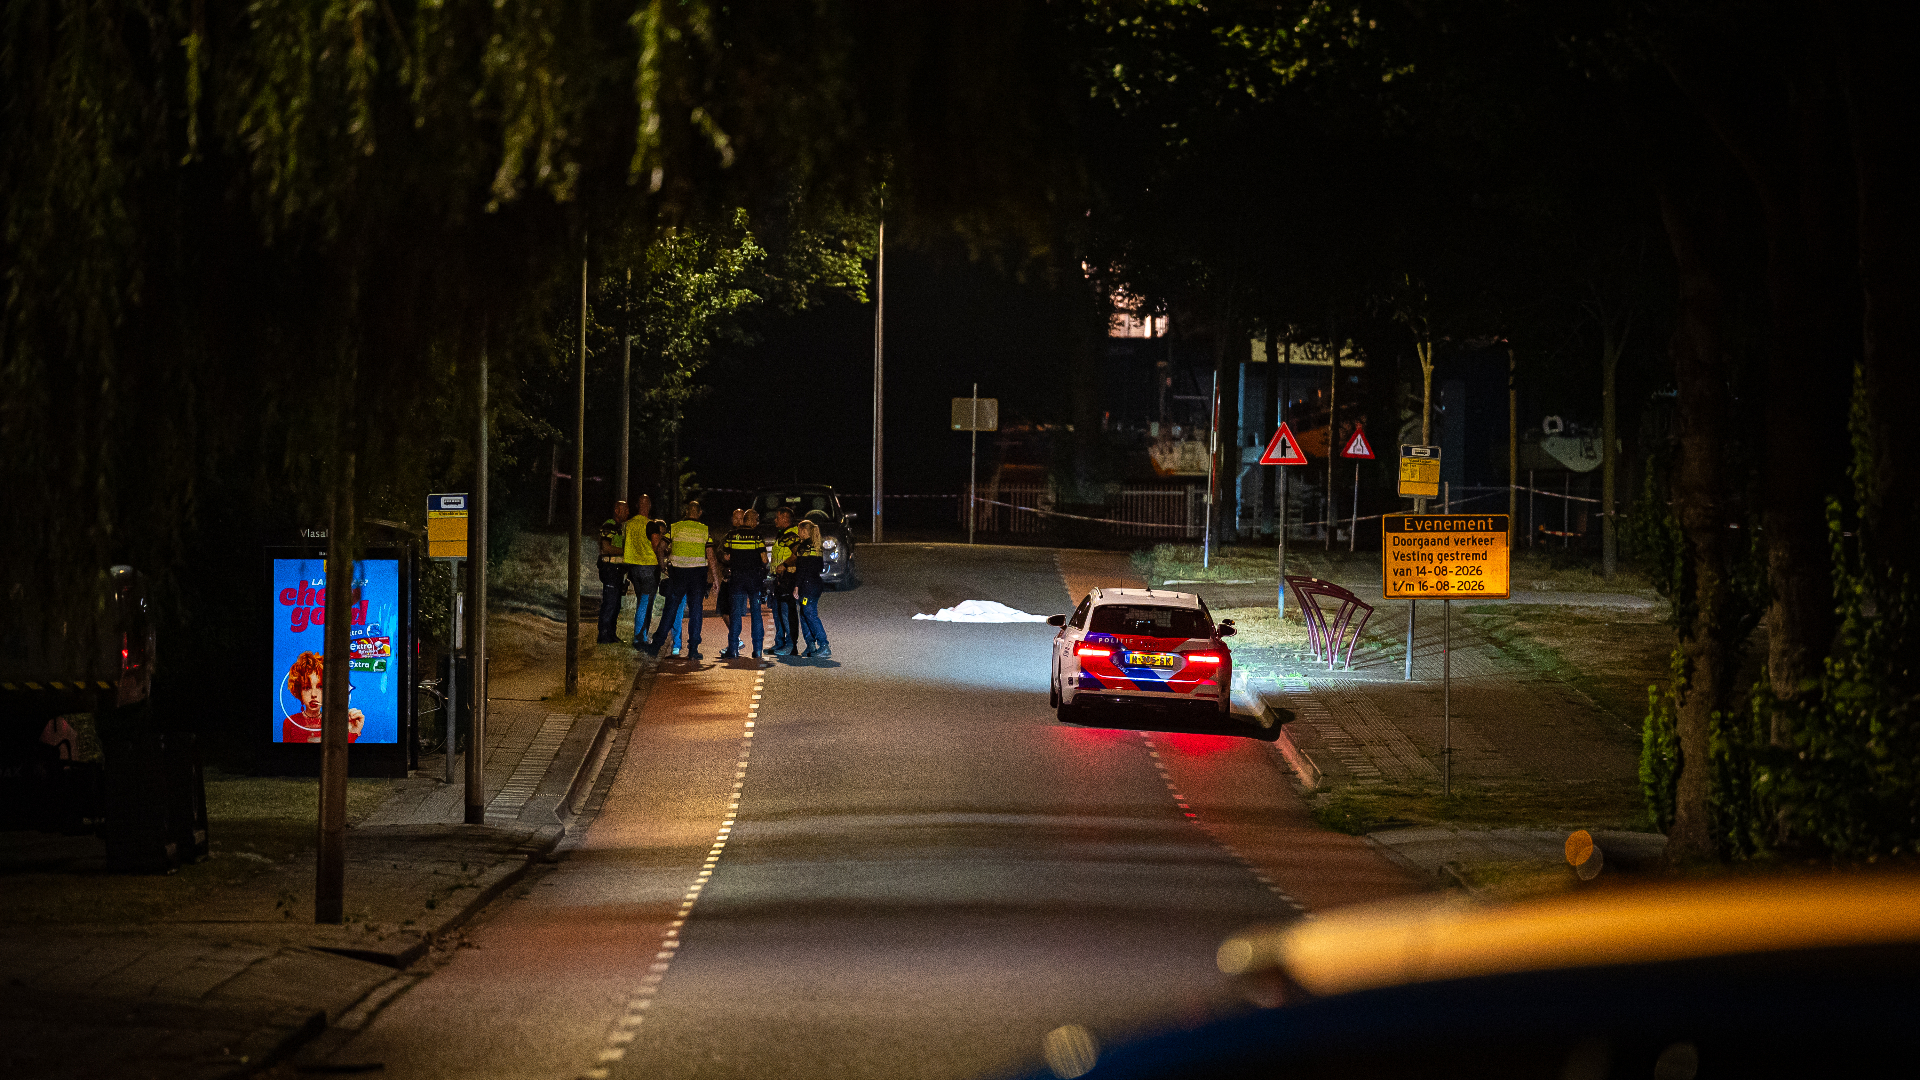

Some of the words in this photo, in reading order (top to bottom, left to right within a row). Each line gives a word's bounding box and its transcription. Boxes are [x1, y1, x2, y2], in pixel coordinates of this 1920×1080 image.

[1404, 517, 1494, 531] Evenement
[1392, 535, 1450, 549] Doorgaand
[1453, 535, 1495, 546] verkeer
[1392, 550, 1434, 564] Vesting
[1437, 550, 1488, 564] gestremd
[1393, 568, 1412, 576] van
[1416, 565, 1483, 576] 14-08-2026
[1393, 580, 1415, 592] t/m
[1418, 580, 1485, 592] 16-08-2026
[290, 599, 369, 633] god
[350, 643, 373, 651] extra
[349, 660, 370, 669] extra
